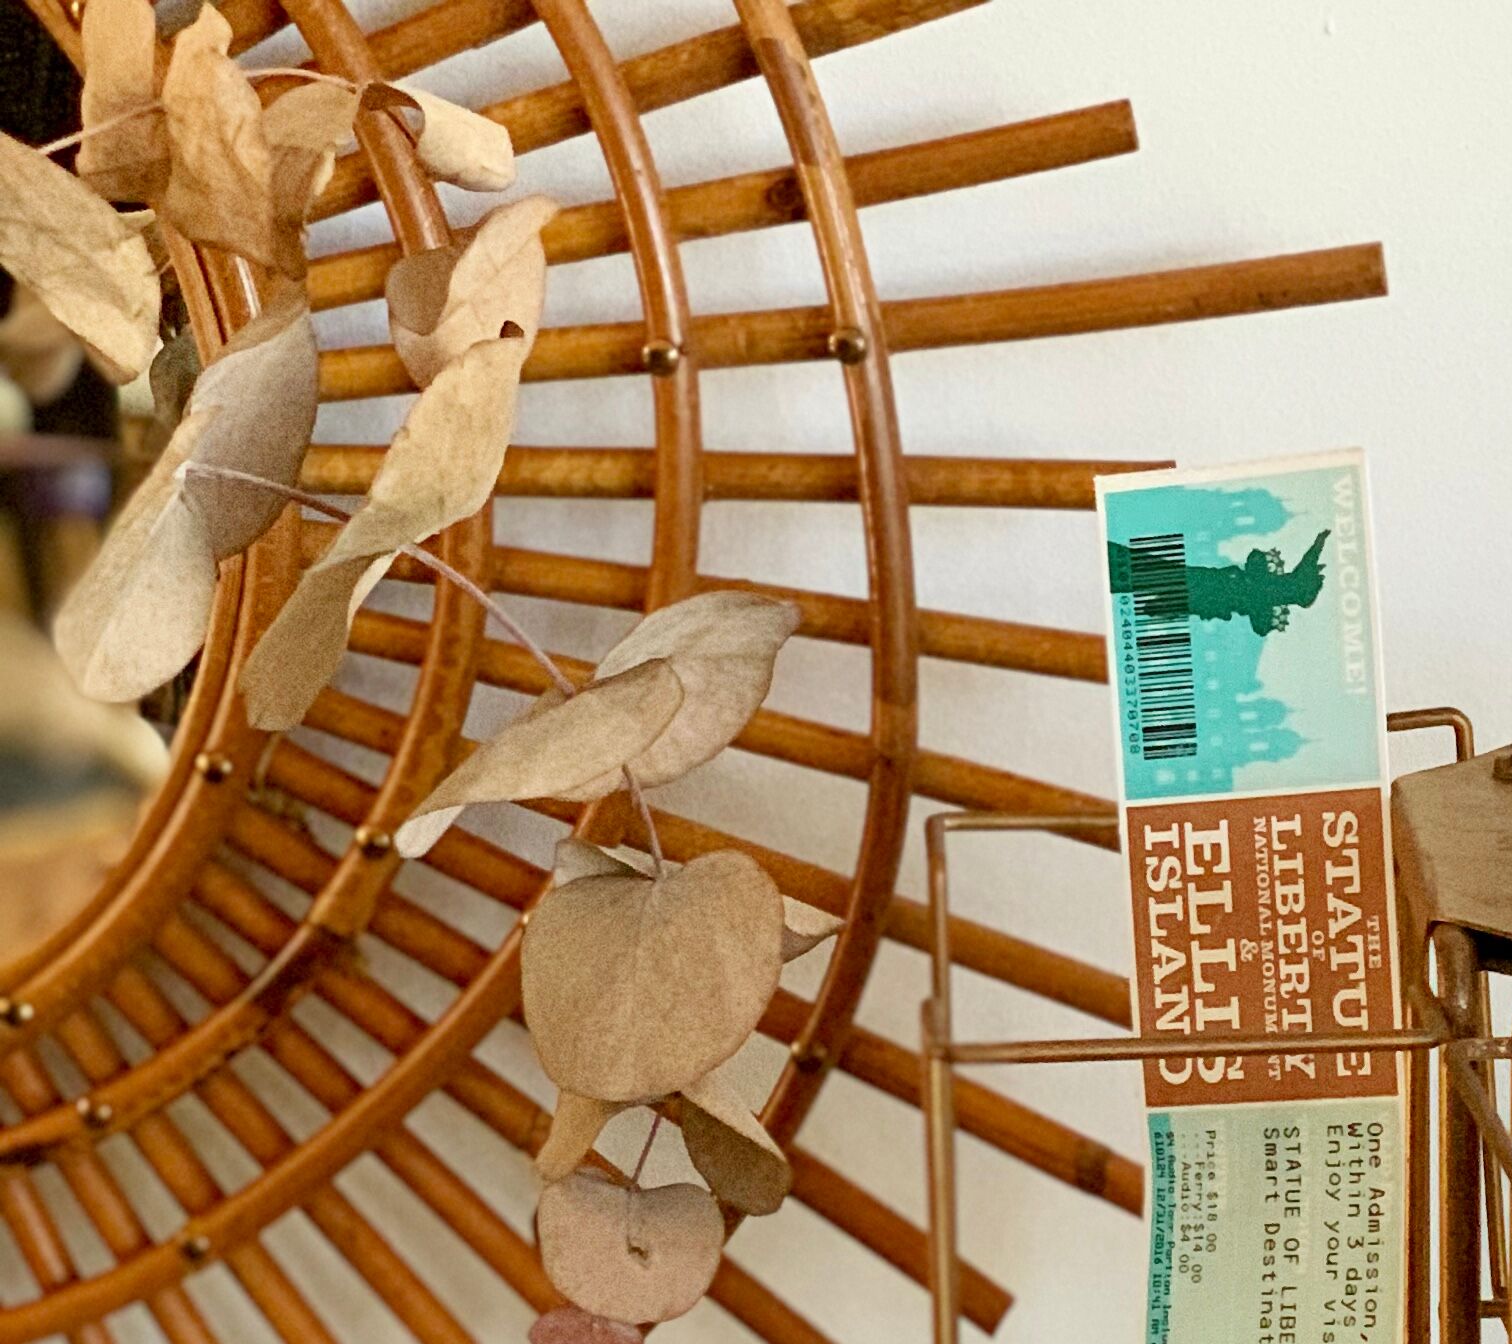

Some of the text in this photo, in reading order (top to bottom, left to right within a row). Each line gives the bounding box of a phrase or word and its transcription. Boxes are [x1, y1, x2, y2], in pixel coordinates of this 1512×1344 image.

[1144, 822, 1193, 1085] ISLAND
[1184, 819, 1245, 1084] ELLIS
[1240, 938, 1258, 963] &
[1253, 816, 1282, 1081] NATIONAL MONUMNT
[1271, 813, 1316, 1079] LIBERTY
[1311, 930, 1326, 962] OF
[1321, 810, 1372, 1077] STATUE
[1366, 915, 1382, 969] THE
[1205, 1129, 1218, 1181] Price
[1263, 1127, 1281, 1203] Smart
[1283, 1125, 1302, 1219] STATUE
[1325, 1124, 1344, 1202] Enjoy
[1347, 1122, 1366, 1218] Within
[1162, 1240, 1175, 1296] Portion
[1283, 1237, 1301, 1266] OF
[1323, 1220, 1340, 1281] your
[1347, 1236, 1365, 1250] 3
[1360, 1122, 1386, 1342] One Admission,
[1340, 1267, 1363, 1327] days
